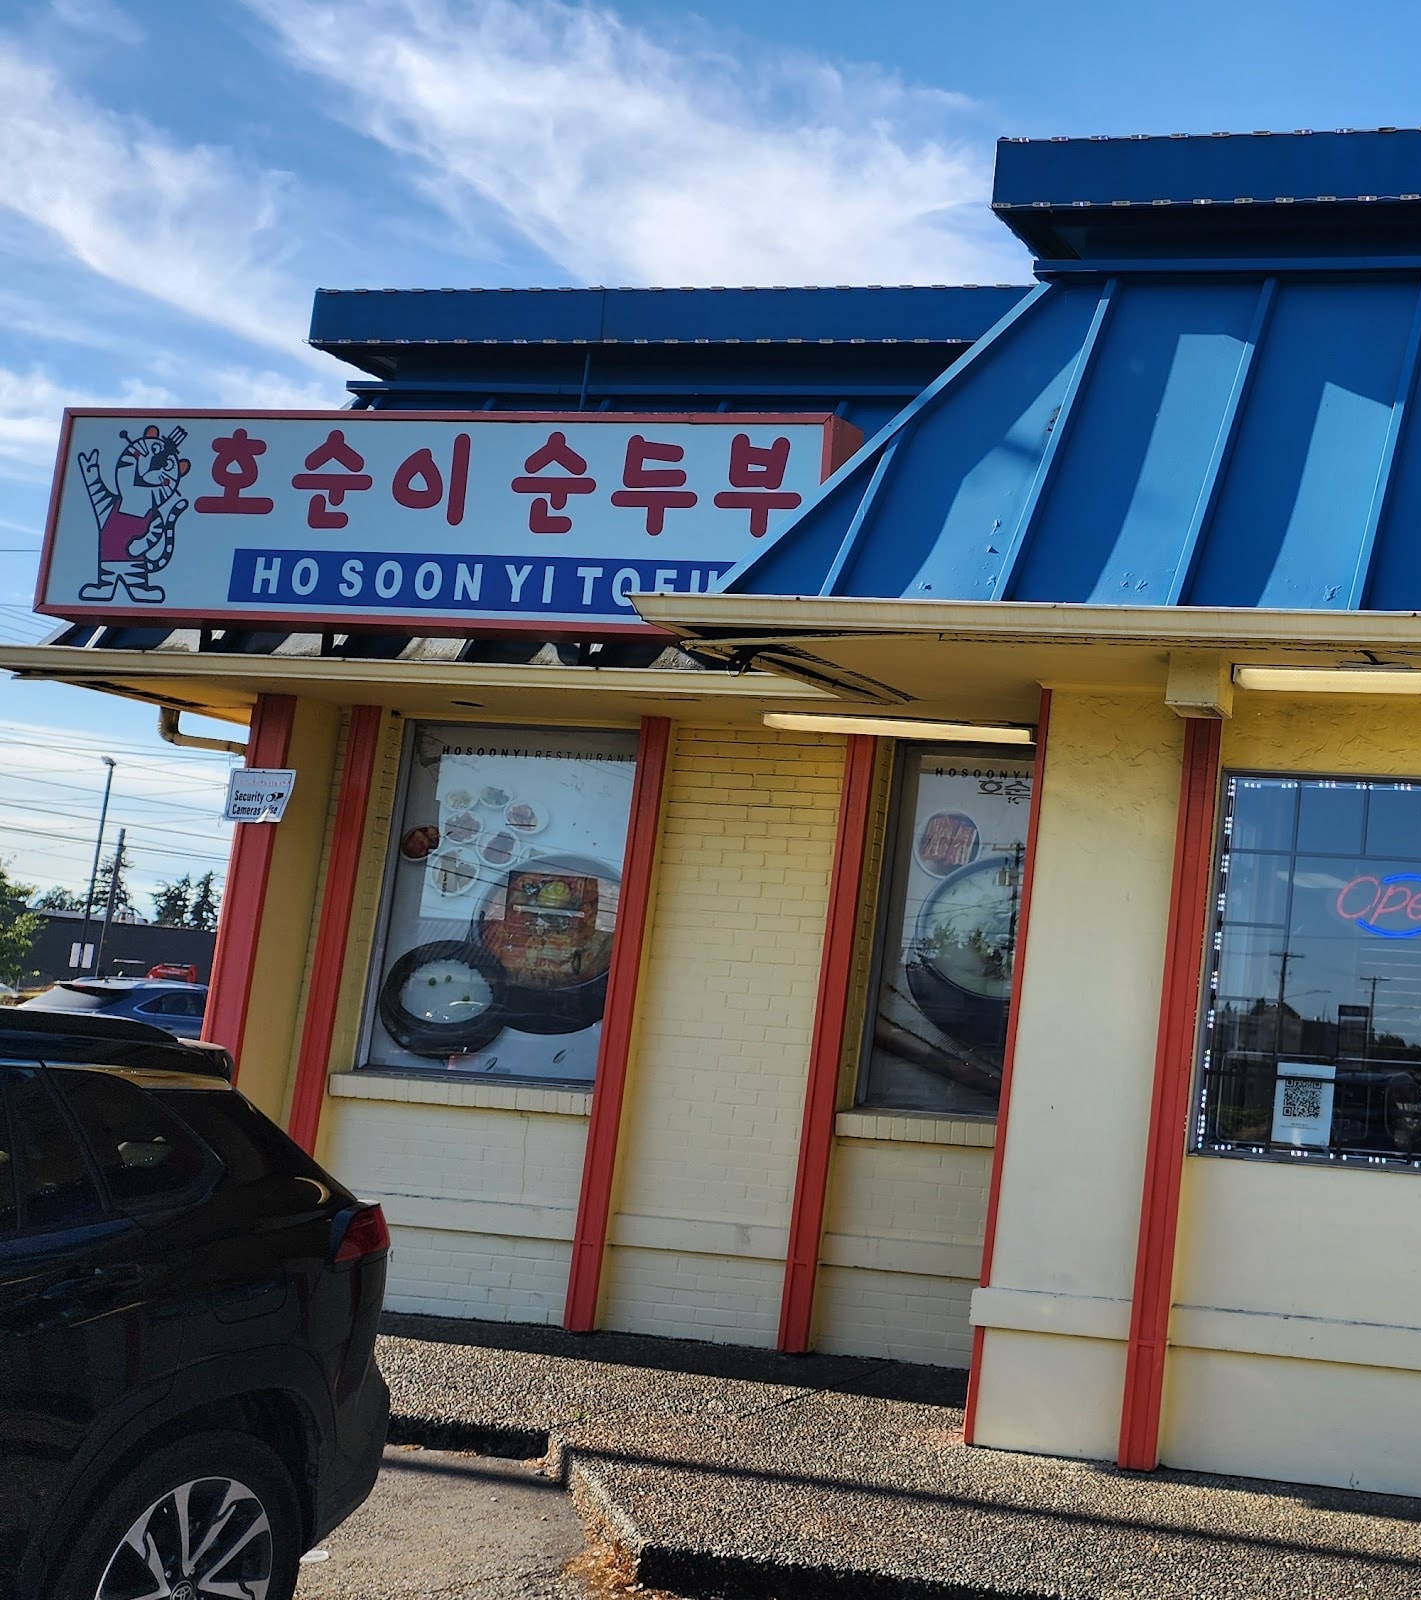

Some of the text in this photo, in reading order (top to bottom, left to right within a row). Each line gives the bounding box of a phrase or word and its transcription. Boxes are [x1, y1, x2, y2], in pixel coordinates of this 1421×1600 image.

[194, 428, 802, 537] 호순이 순두부
[252, 557, 320, 596] HO
[338, 560, 483, 602] SOON
[505, 565, 555, 604] YI
[442, 745, 635, 763] HOSOONYI RESTAURANT
[935, 767, 1029, 780] HOSOONYI
[234, 790, 264, 804] Security
[232, 804, 261, 816] Cameras
